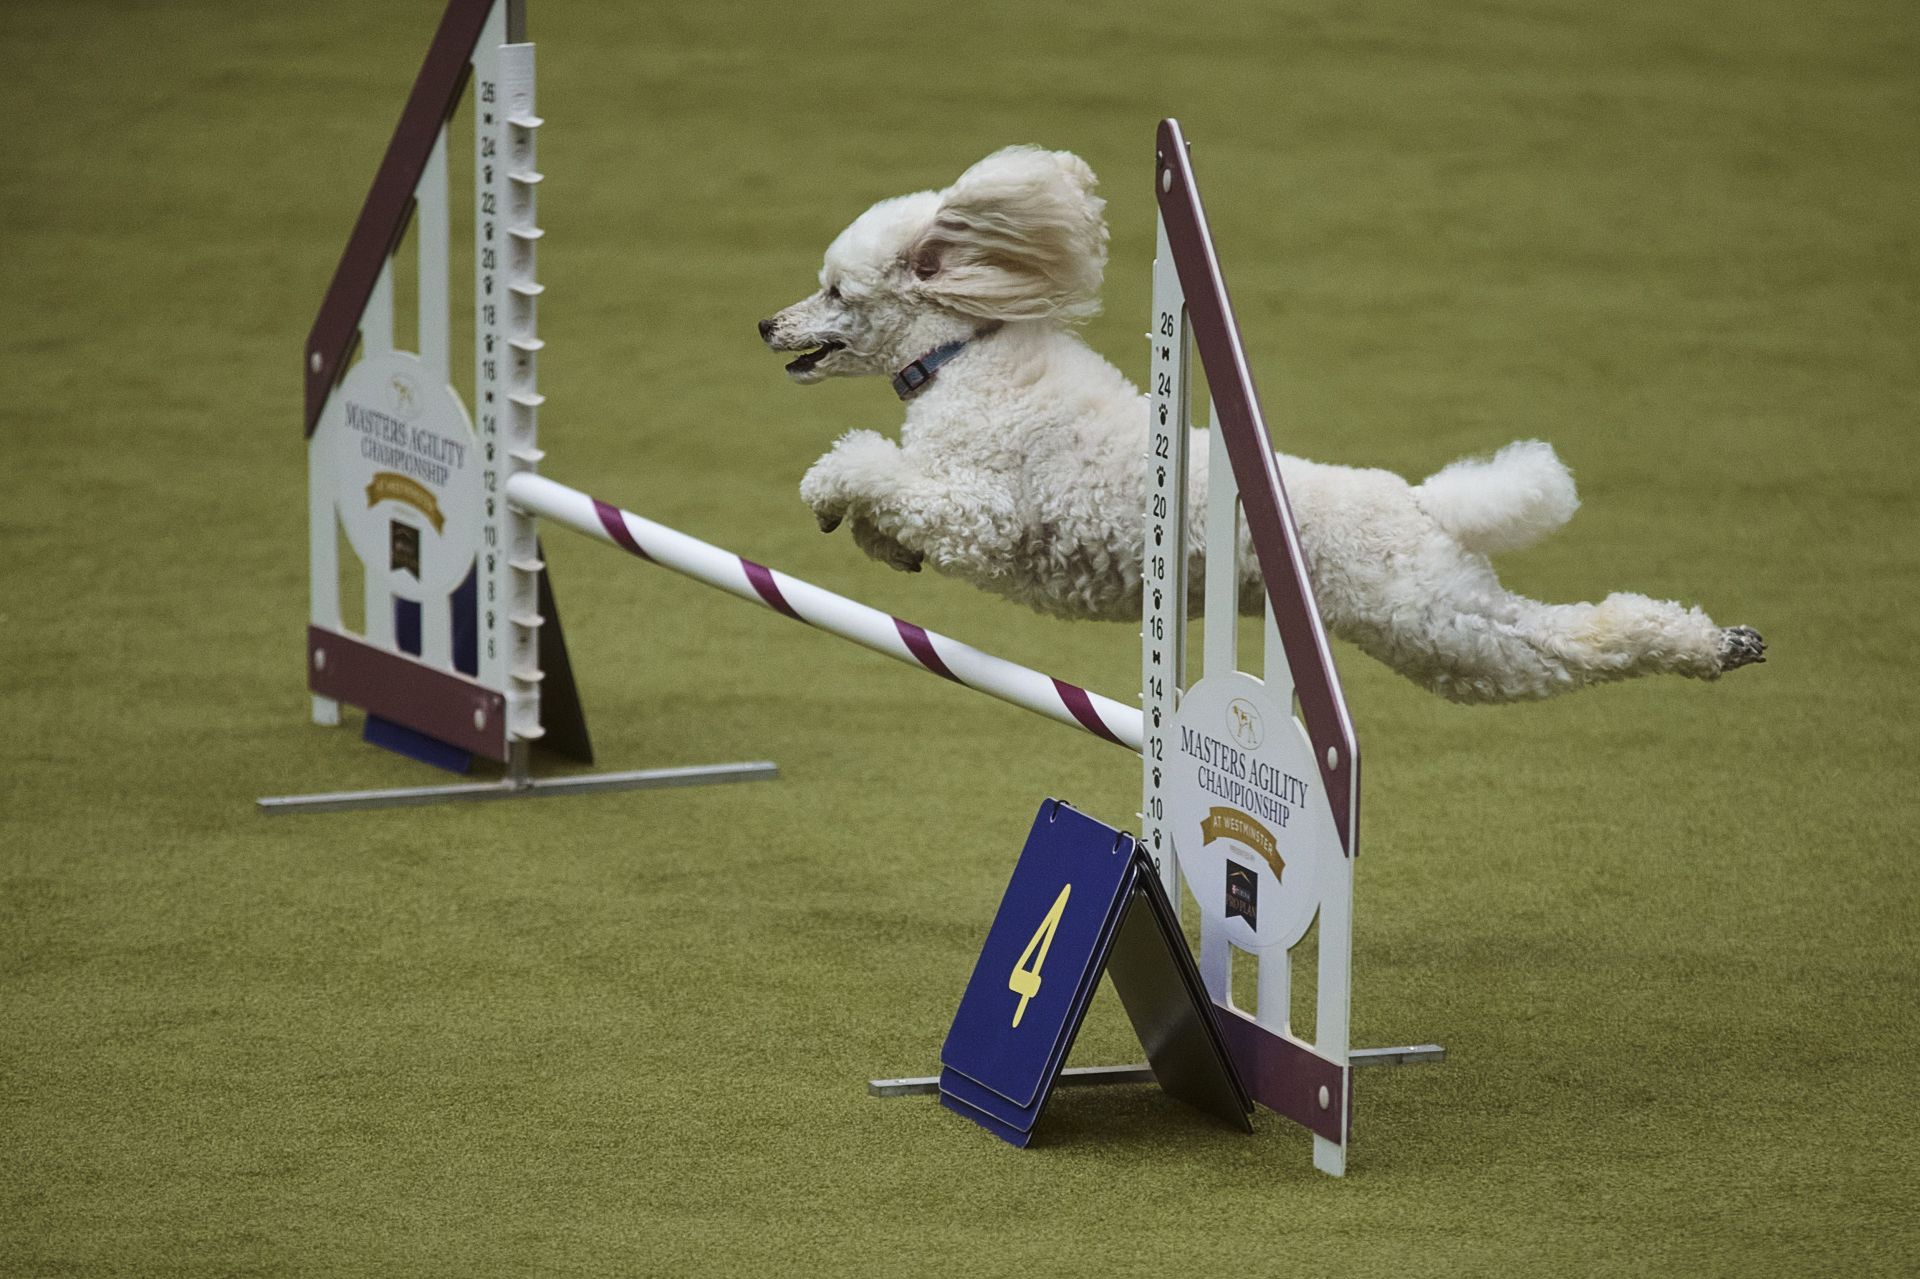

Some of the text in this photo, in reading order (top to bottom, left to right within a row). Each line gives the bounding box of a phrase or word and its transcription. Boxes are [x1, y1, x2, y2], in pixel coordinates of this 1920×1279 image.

[481, 81, 496, 103] 26
[481, 136, 496, 158] 24
[481, 192, 496, 215] 22
[481, 248, 495, 270] 20
[482, 305, 495, 326] 18
[1160, 311, 1174, 338] 26
[1158, 372, 1171, 398] 24
[345, 401, 466, 470] MASTERS AGILITY
[1155, 433, 1169, 459] 22
[360, 436, 449, 488] CHAMPIONSHIP
[483, 470, 496, 492] 12
[1153, 493, 1166, 519] 20
[484, 525, 495, 547] 10
[1151, 554, 1164, 580] 18
[1150, 615, 1163, 641] 16
[1149, 675, 1162, 701] 14
[1149, 735, 1163, 762] 12
[1180, 725, 1309, 809] MASTERS AGILITY
[1150, 796, 1163, 821] 10
[1198, 765, 1290, 828] CHAMPIONSHIP
[1213, 815, 1223, 829] AT
[1224, 816, 1274, 857] WESTMINSTER
[1009, 883, 1071, 1029] 4
